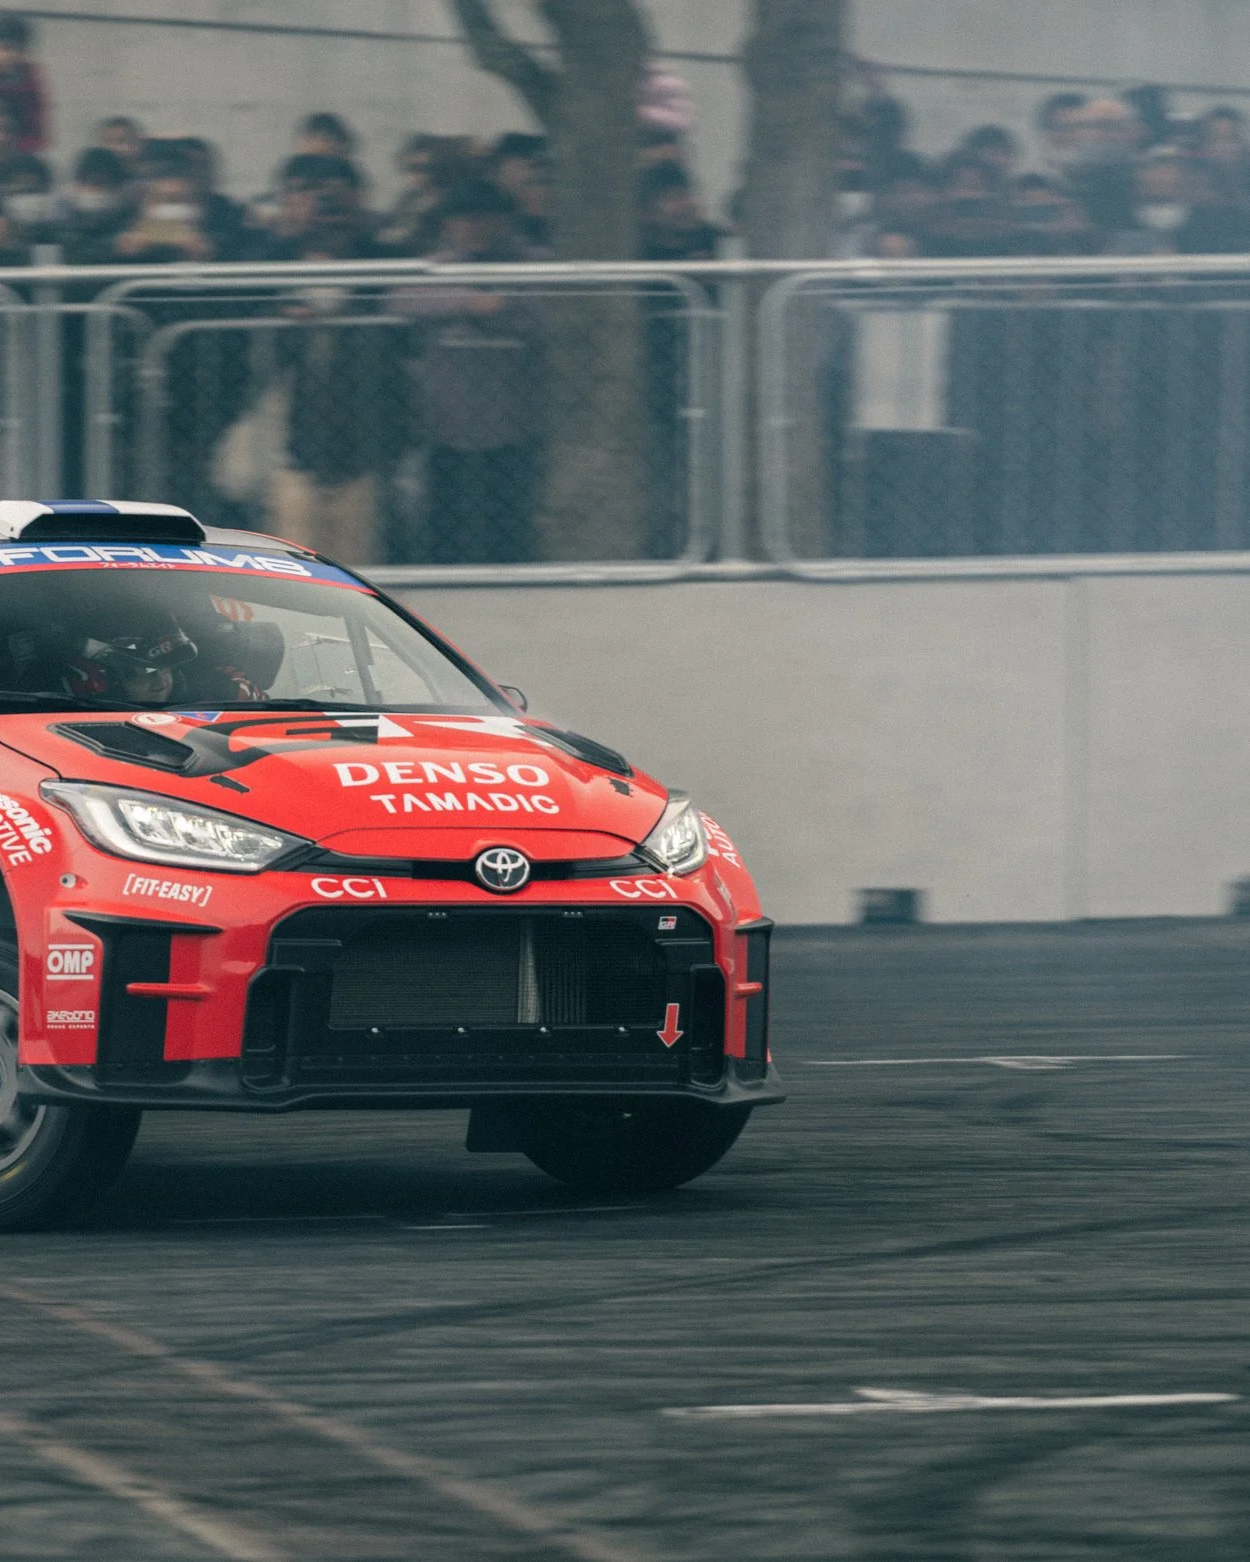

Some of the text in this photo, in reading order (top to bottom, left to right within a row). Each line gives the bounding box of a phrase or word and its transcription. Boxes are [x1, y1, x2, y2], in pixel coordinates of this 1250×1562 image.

[333, 761, 551, 787] DENSO
[369, 791, 561, 815] TAMADIC
[47, 950, 95, 974] OMP
